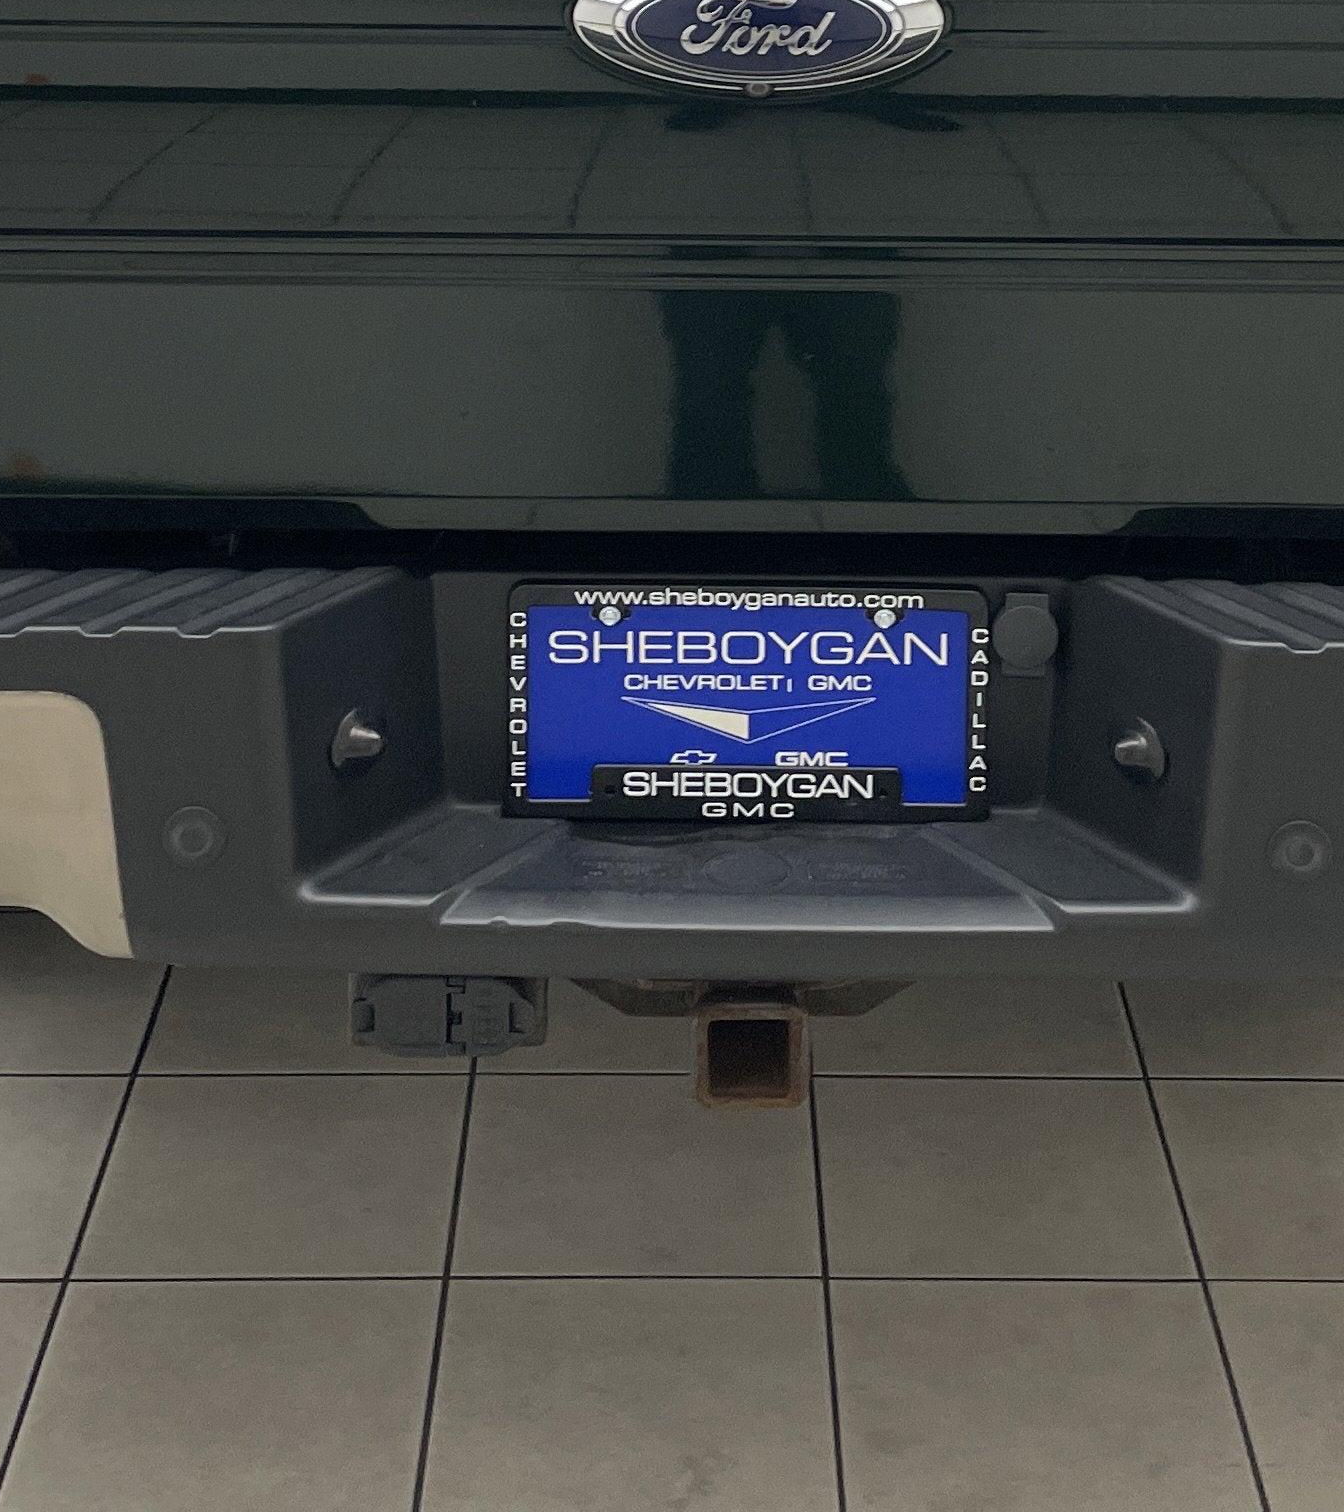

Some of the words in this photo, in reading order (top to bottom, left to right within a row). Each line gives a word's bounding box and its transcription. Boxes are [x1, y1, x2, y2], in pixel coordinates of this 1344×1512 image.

[574, 587, 924, 611] www.sheboyganauto.com
[548, 630, 949, 666] SHEBOYGAN
[623, 674, 785, 691] CHEVROLET
[807, 674, 873, 691] GMC
[509, 612, 528, 797] CHEVROLET
[968, 628, 990, 792] CADILLAC
[774, 751, 849, 767] GMC
[622, 771, 874, 799] SHEBOYGAN
[701, 802, 795, 818] GMC
